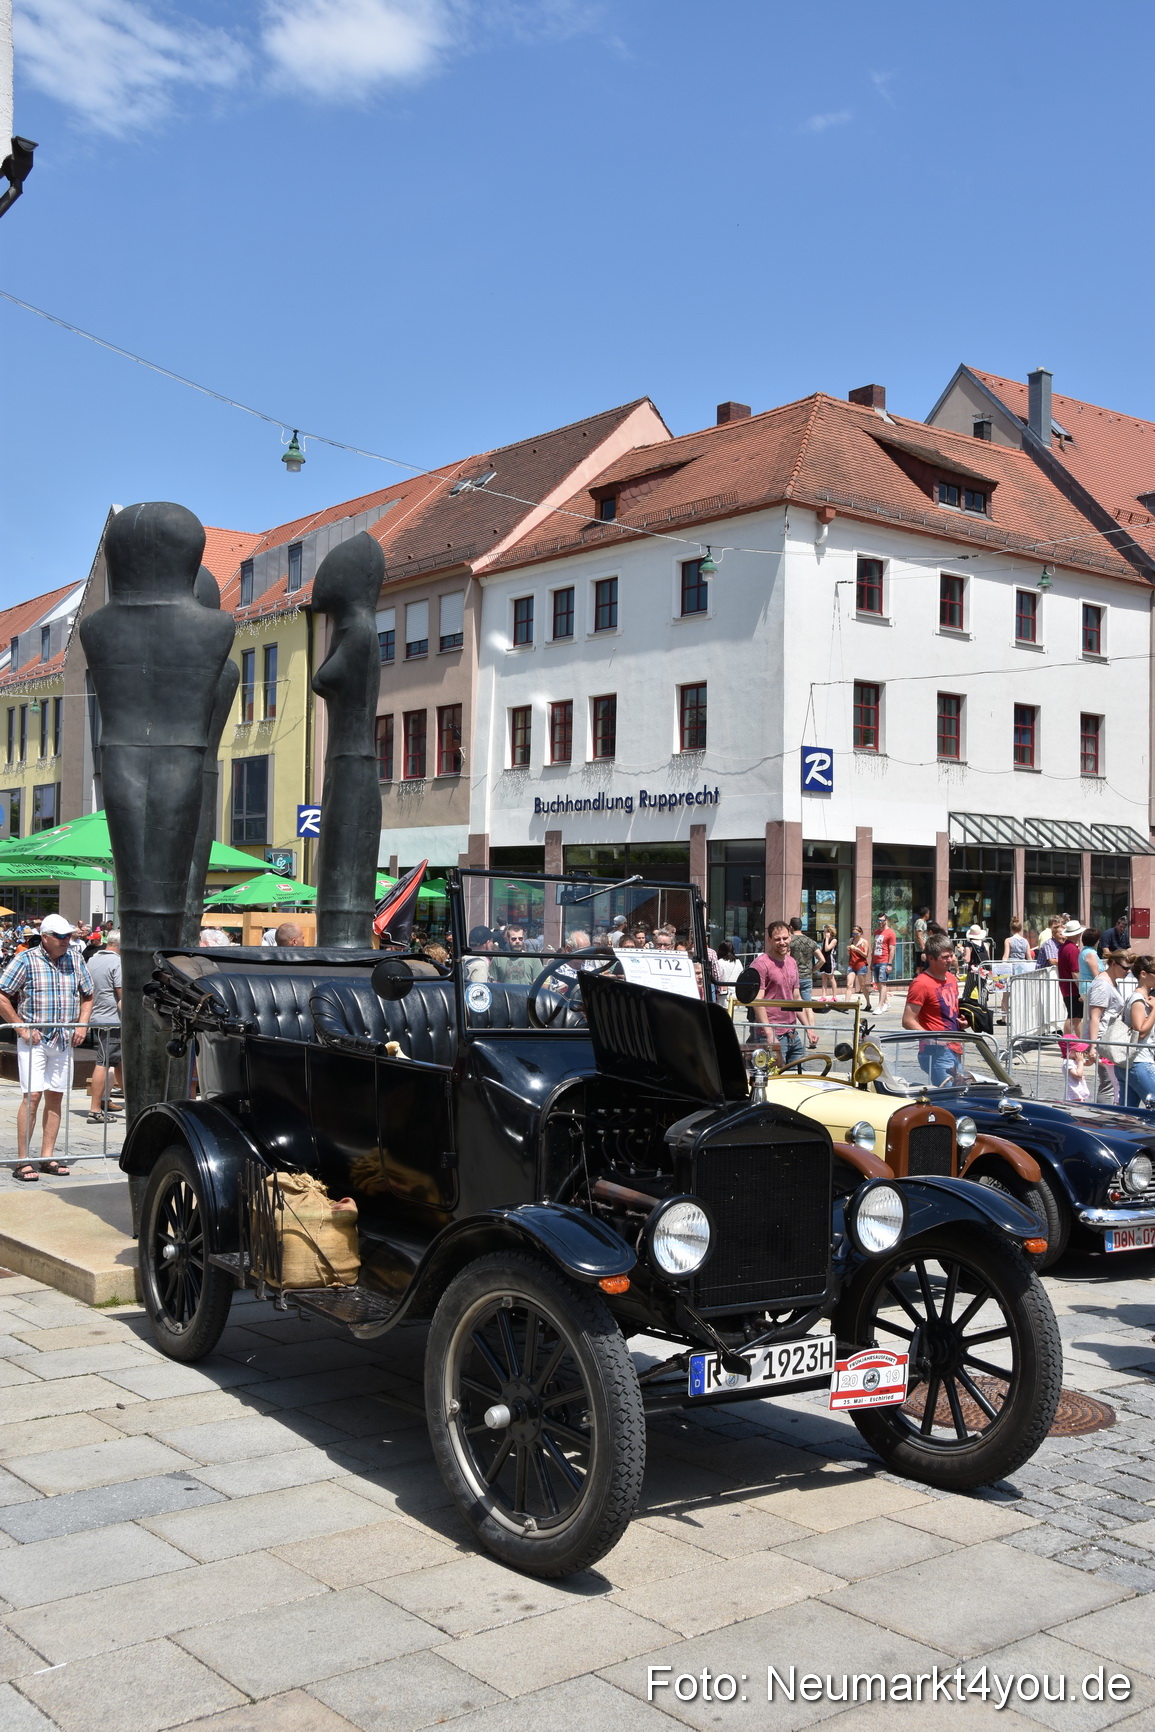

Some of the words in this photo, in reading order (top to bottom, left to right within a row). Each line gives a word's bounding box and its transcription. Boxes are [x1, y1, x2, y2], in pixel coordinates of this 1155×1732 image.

[534, 791, 634, 814] Buchhandlung
[639, 784, 720, 812] Rupprecht
[654, 958, 682, 971] 712
[694, 1379, 701, 1388] D
[841, 1373, 859, 1388] 20
[885, 1369, 900, 1383] 19
